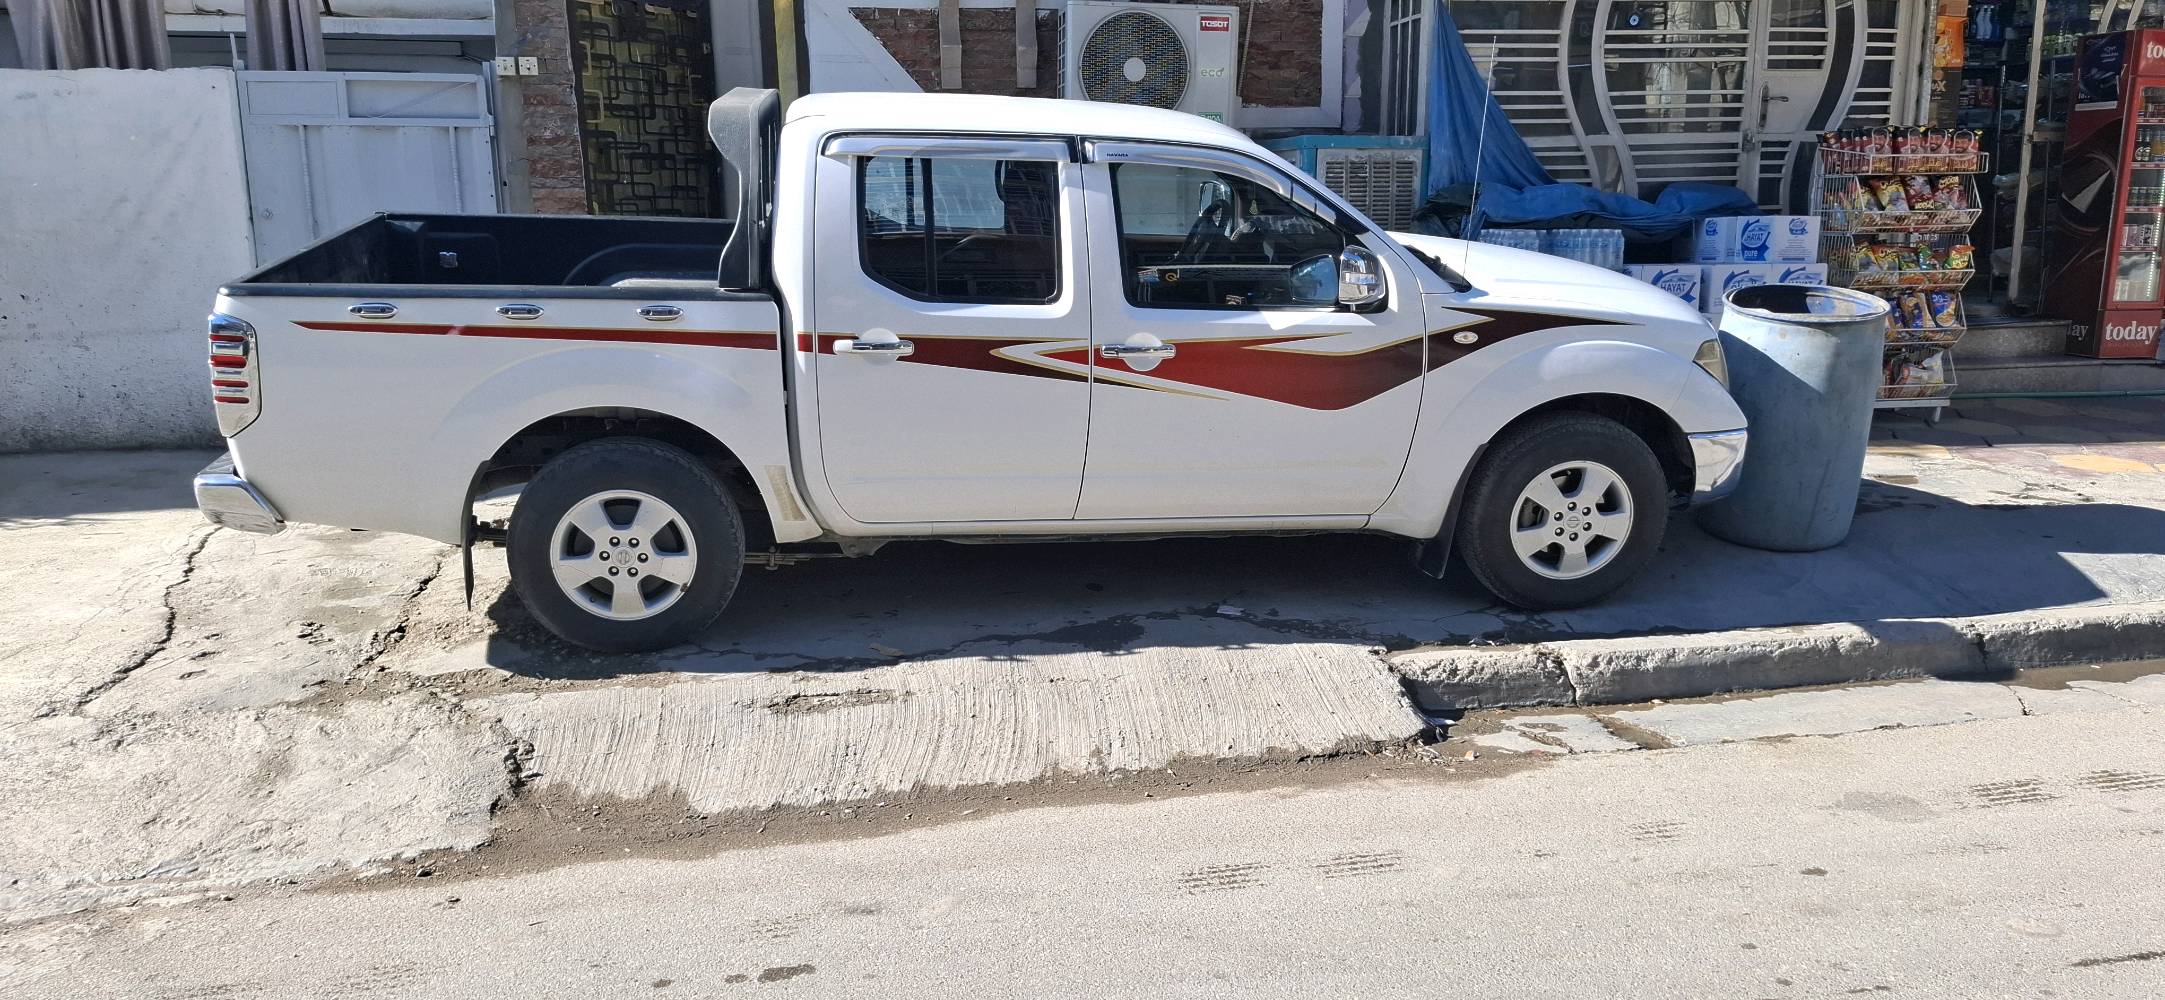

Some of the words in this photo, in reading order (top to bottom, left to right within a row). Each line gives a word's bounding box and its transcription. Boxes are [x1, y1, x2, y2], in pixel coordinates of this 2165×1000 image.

[1200, 68, 1224, 77] eco
[1660, 282, 1687, 292] HAYAT
[2105, 320, 2158, 345] today
